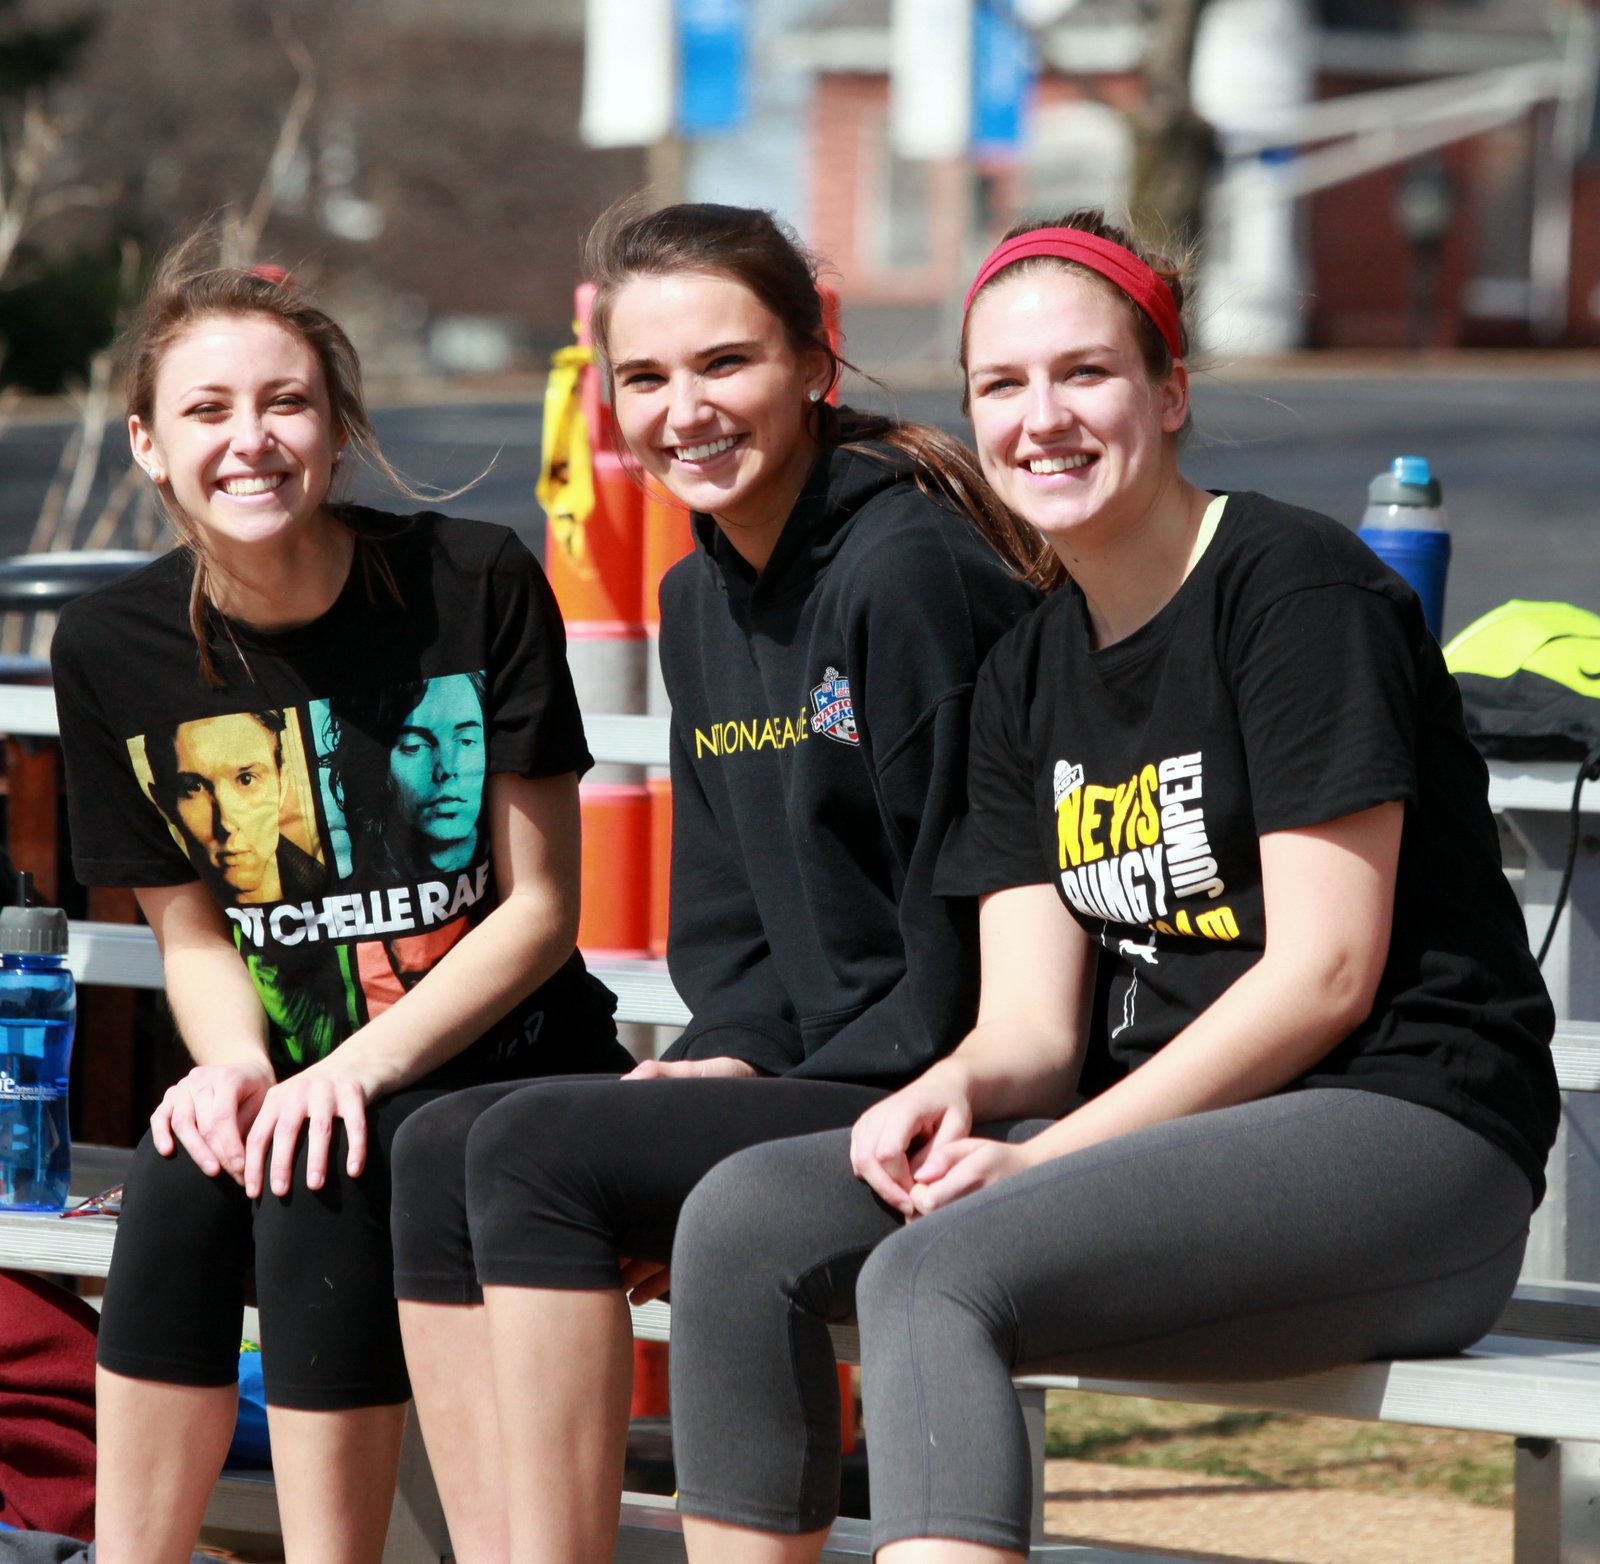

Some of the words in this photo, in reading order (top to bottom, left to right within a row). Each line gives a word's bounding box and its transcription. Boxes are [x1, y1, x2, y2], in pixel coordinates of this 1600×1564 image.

[814, 699, 852, 727] NATIO
[822, 709, 854, 729] LEA
[695, 718, 778, 759] NTIONA
[1158, 751, 1225, 899] JUMPER
[269, 886, 415, 947] CHELLE
[0, 1071, 15, 1093] ie
